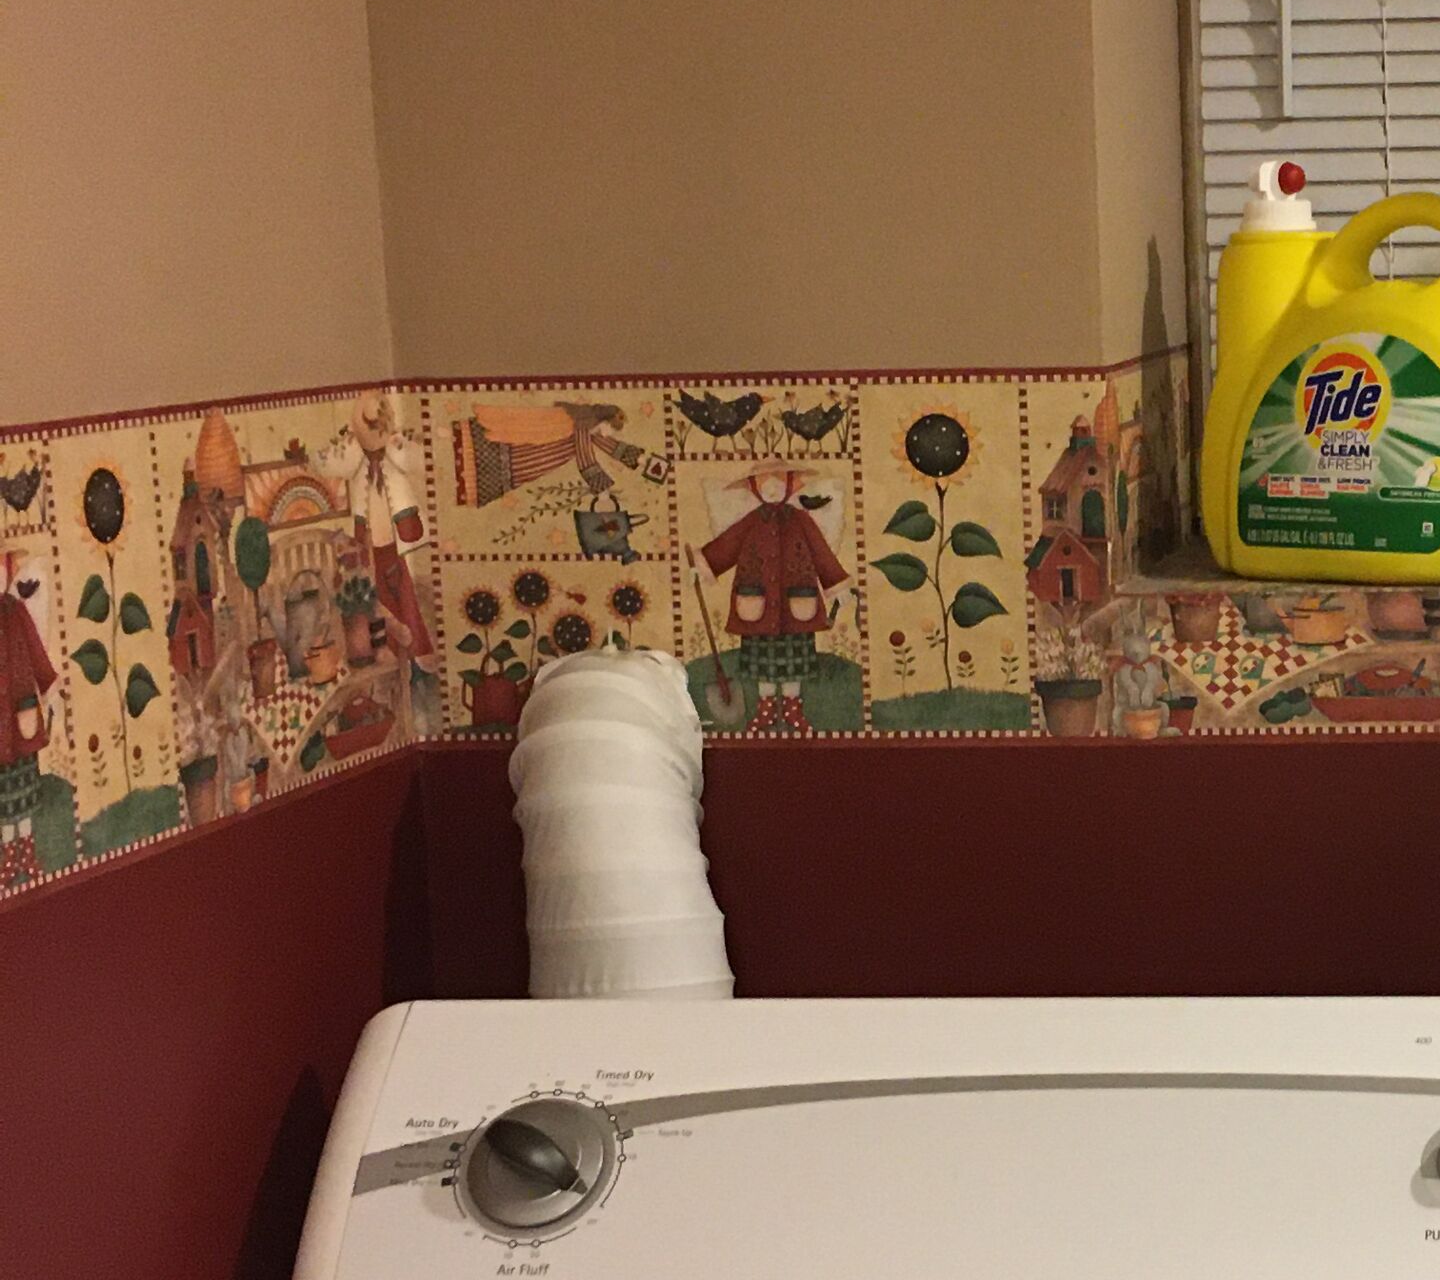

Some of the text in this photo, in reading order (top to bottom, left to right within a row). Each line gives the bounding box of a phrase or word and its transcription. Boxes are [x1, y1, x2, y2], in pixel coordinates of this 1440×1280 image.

[1304, 368, 1383, 436] Tide
[1322, 430, 1370, 445] SIMPLY
[1320, 444, 1370, 458] CLEAN
[1317, 458, 1373, 471] &FRESH
[596, 1069, 655, 1081] Timed Dry
[405, 1116, 460, 1129] Auto Dry
[496, 1263, 551, 1276] Air Fluff
